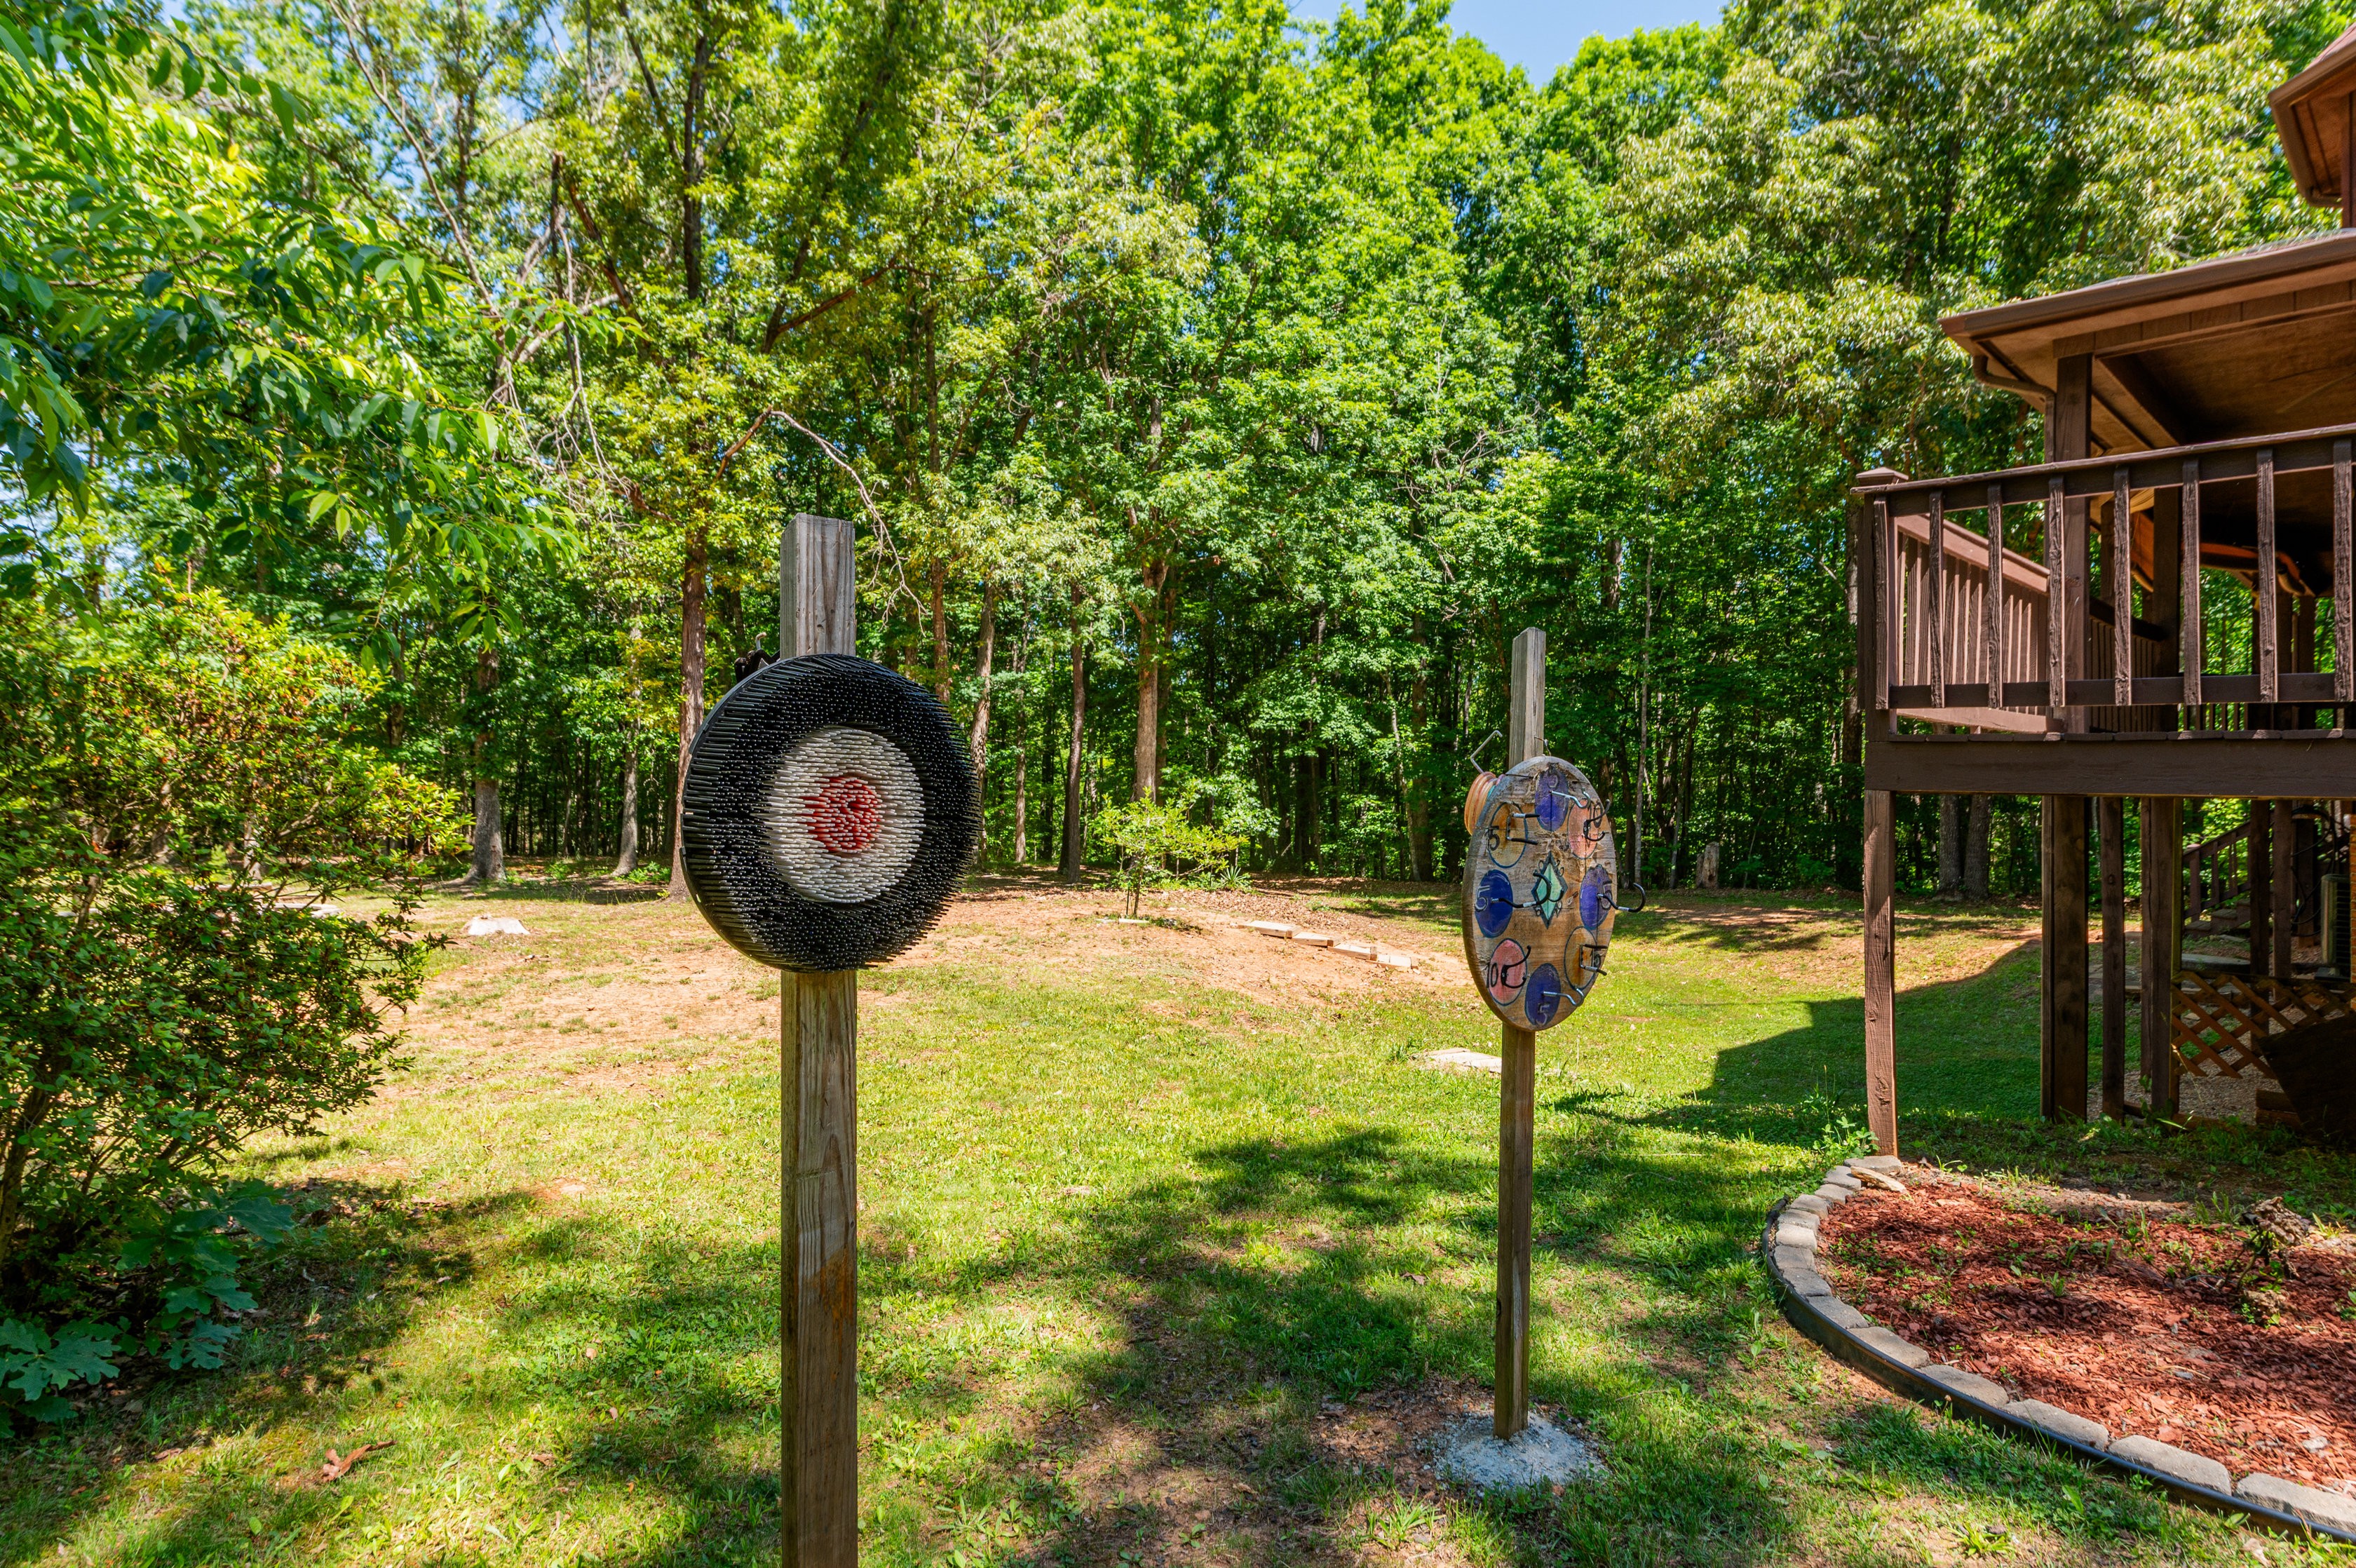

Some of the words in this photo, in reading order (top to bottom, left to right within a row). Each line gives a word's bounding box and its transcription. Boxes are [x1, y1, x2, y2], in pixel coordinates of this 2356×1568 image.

[1547, 762, 1559, 790] 5
[1474, 885, 1491, 912] 5
[1602, 880, 1613, 911] 5
[1484, 961, 1499, 989] 10
[1535, 1001, 1551, 1028] 5
